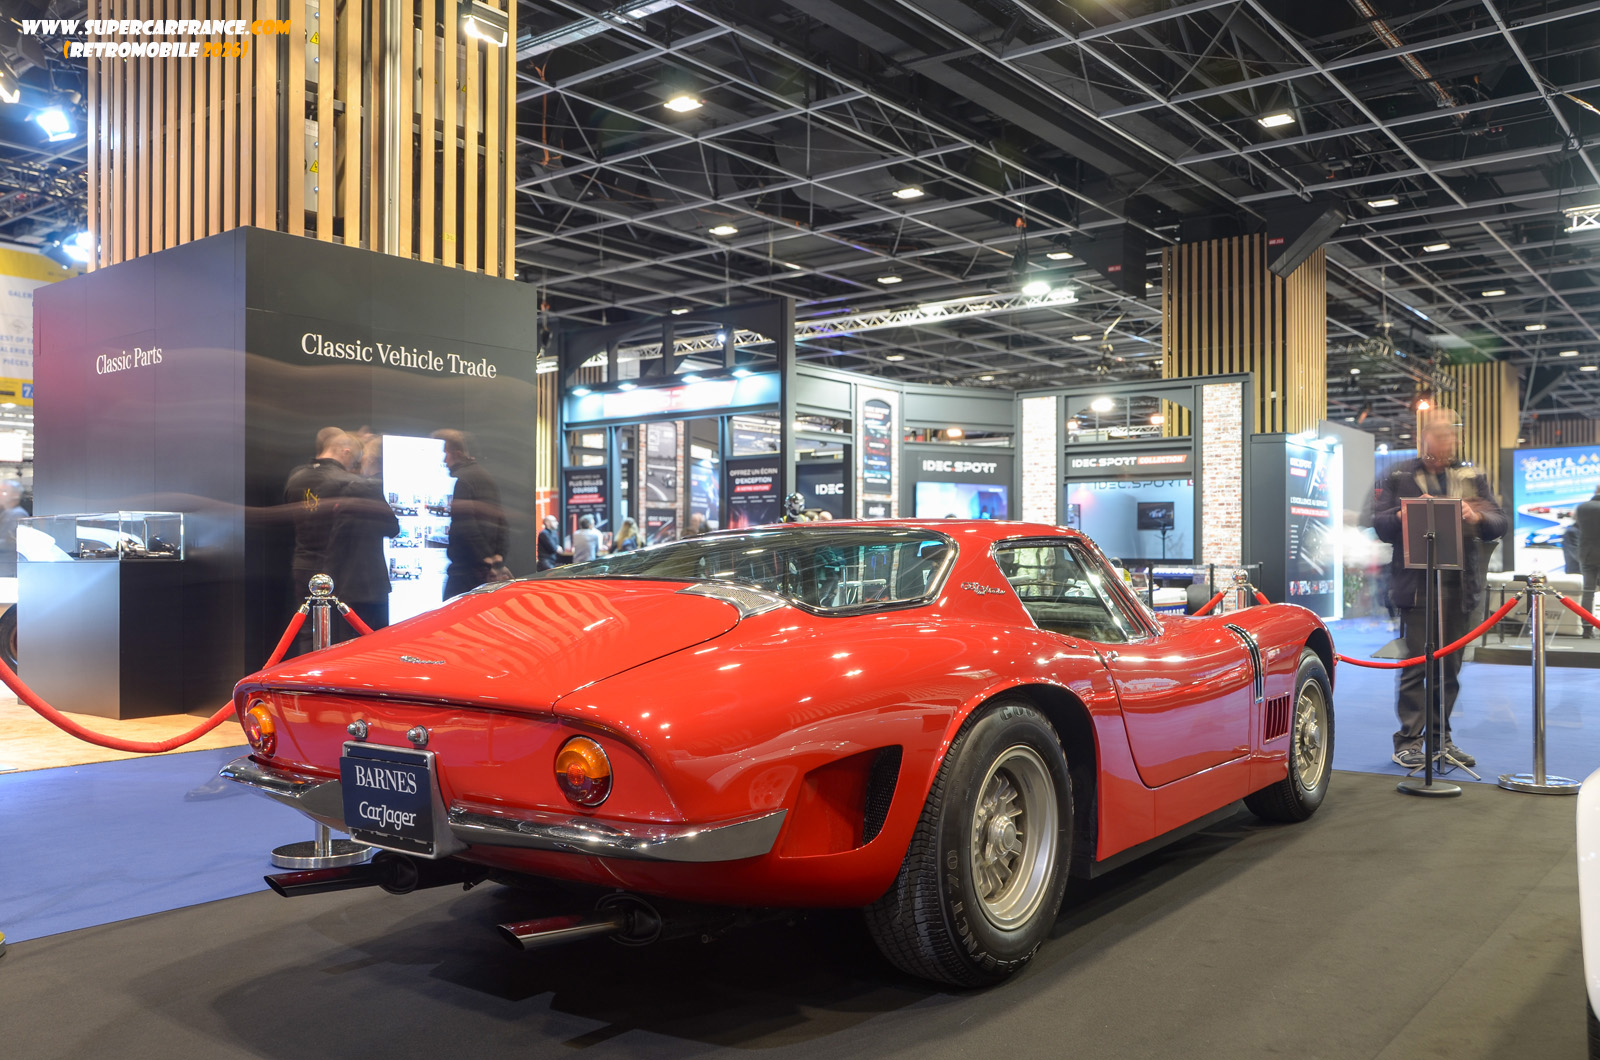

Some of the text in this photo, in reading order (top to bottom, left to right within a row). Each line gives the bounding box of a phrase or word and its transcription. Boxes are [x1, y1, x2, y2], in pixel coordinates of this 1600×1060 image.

[96, 346, 163, 375] Classic Parts
[301, 333, 497, 379] Classic Vehicle Trade
[923, 460, 997, 473] IDEC.SPORT
[1072, 457, 1137, 468] IDEC.SPORT
[815, 484, 845, 495] IDEC
[355, 765, 417, 794] BARNES
[359, 801, 417, 830] CarJager
